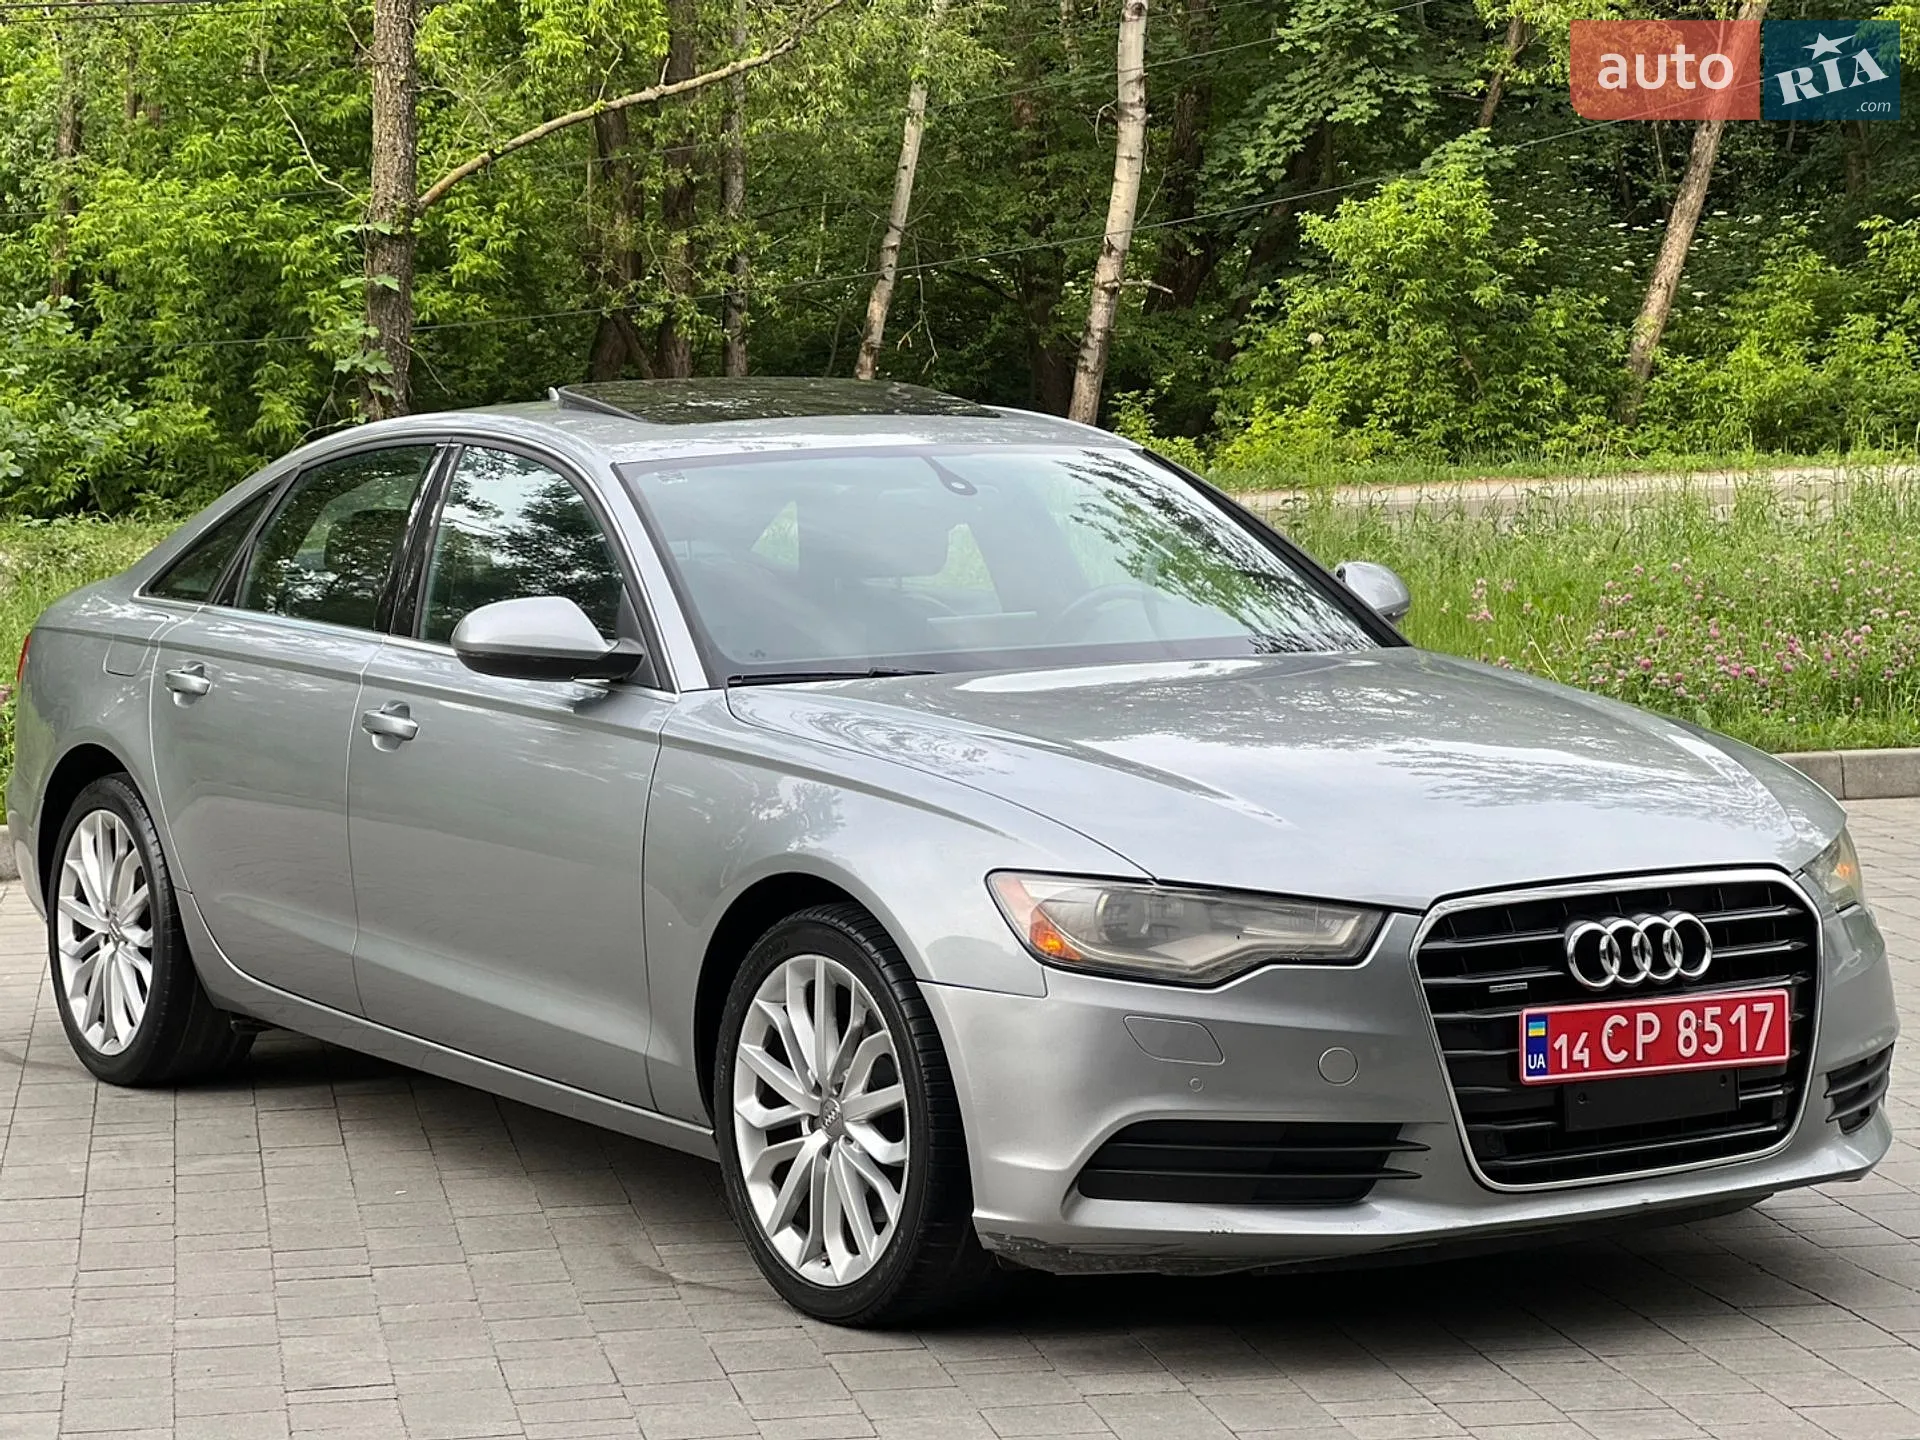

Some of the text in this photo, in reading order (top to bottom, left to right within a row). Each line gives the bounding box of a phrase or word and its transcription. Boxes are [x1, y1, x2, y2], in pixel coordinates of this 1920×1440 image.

[1553, 1003, 1775, 1069] 14 CP 8517
[1528, 1053, 1546, 1069] UA
